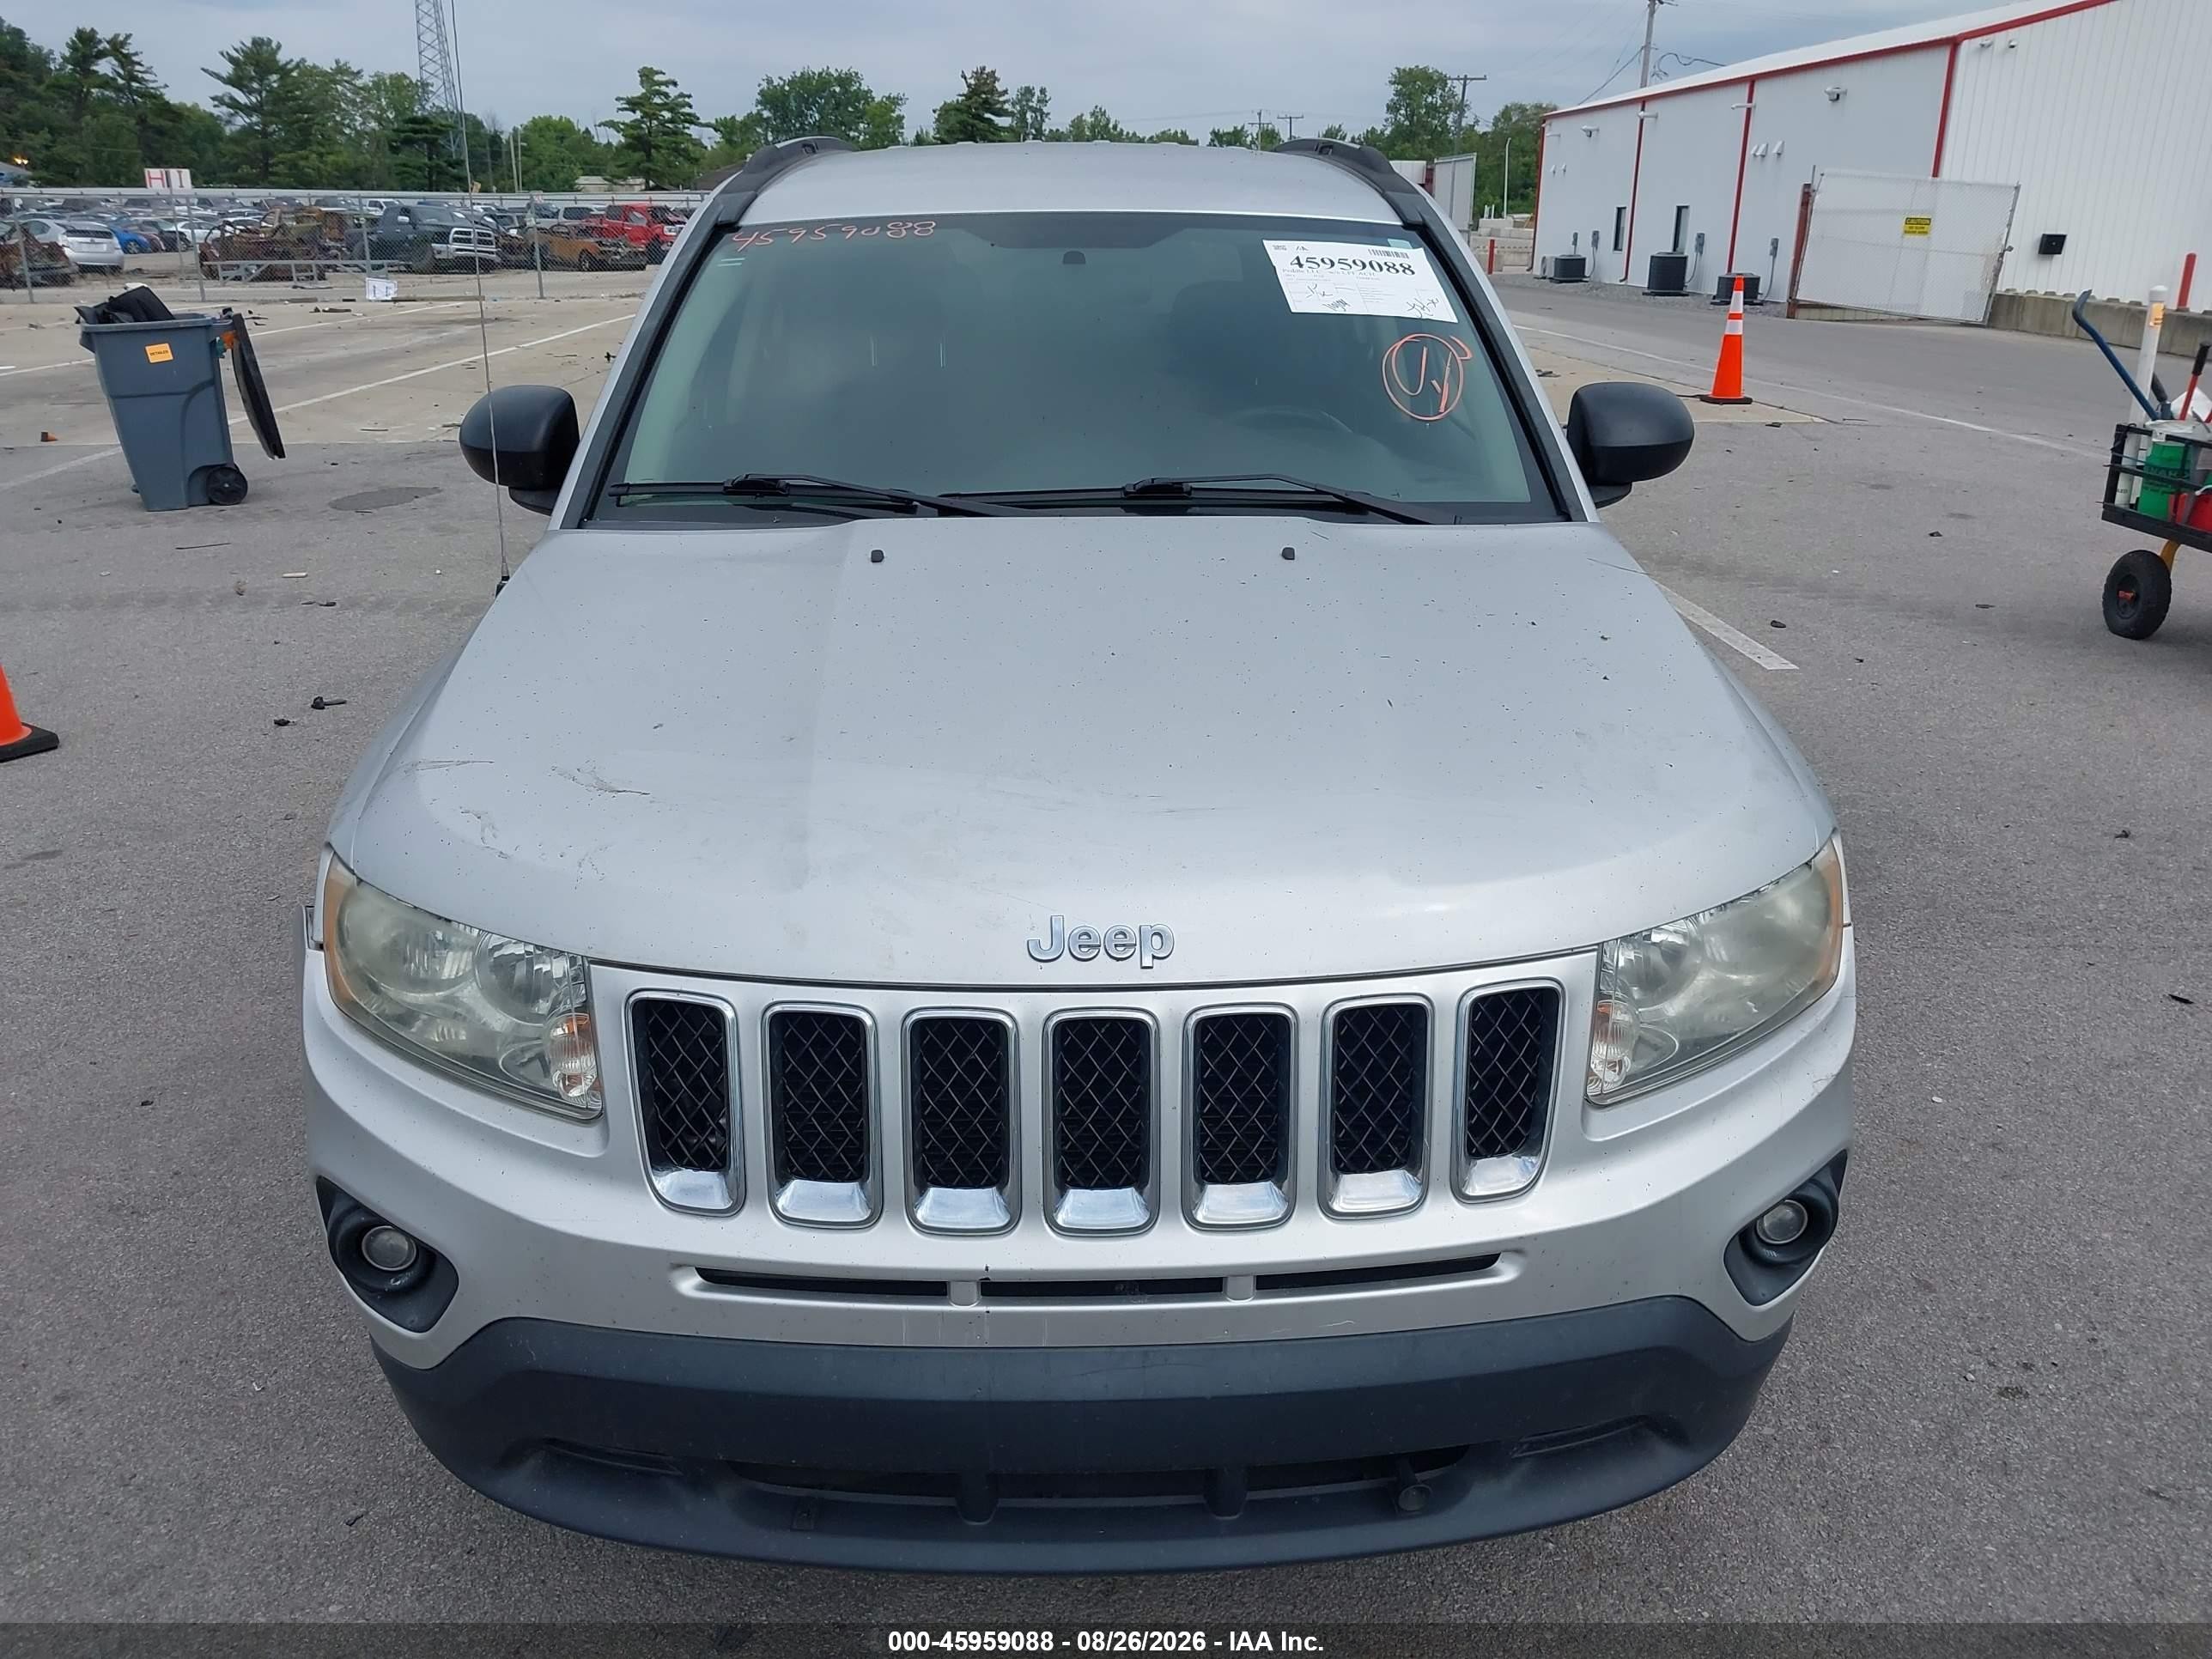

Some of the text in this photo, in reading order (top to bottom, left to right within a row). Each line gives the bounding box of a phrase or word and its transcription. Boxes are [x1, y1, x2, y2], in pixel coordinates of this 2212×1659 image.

[732, 221, 936, 252] 45959088
[1290, 255, 1415, 276] 45959088
[1027, 915, 1175, 969] Jeep
